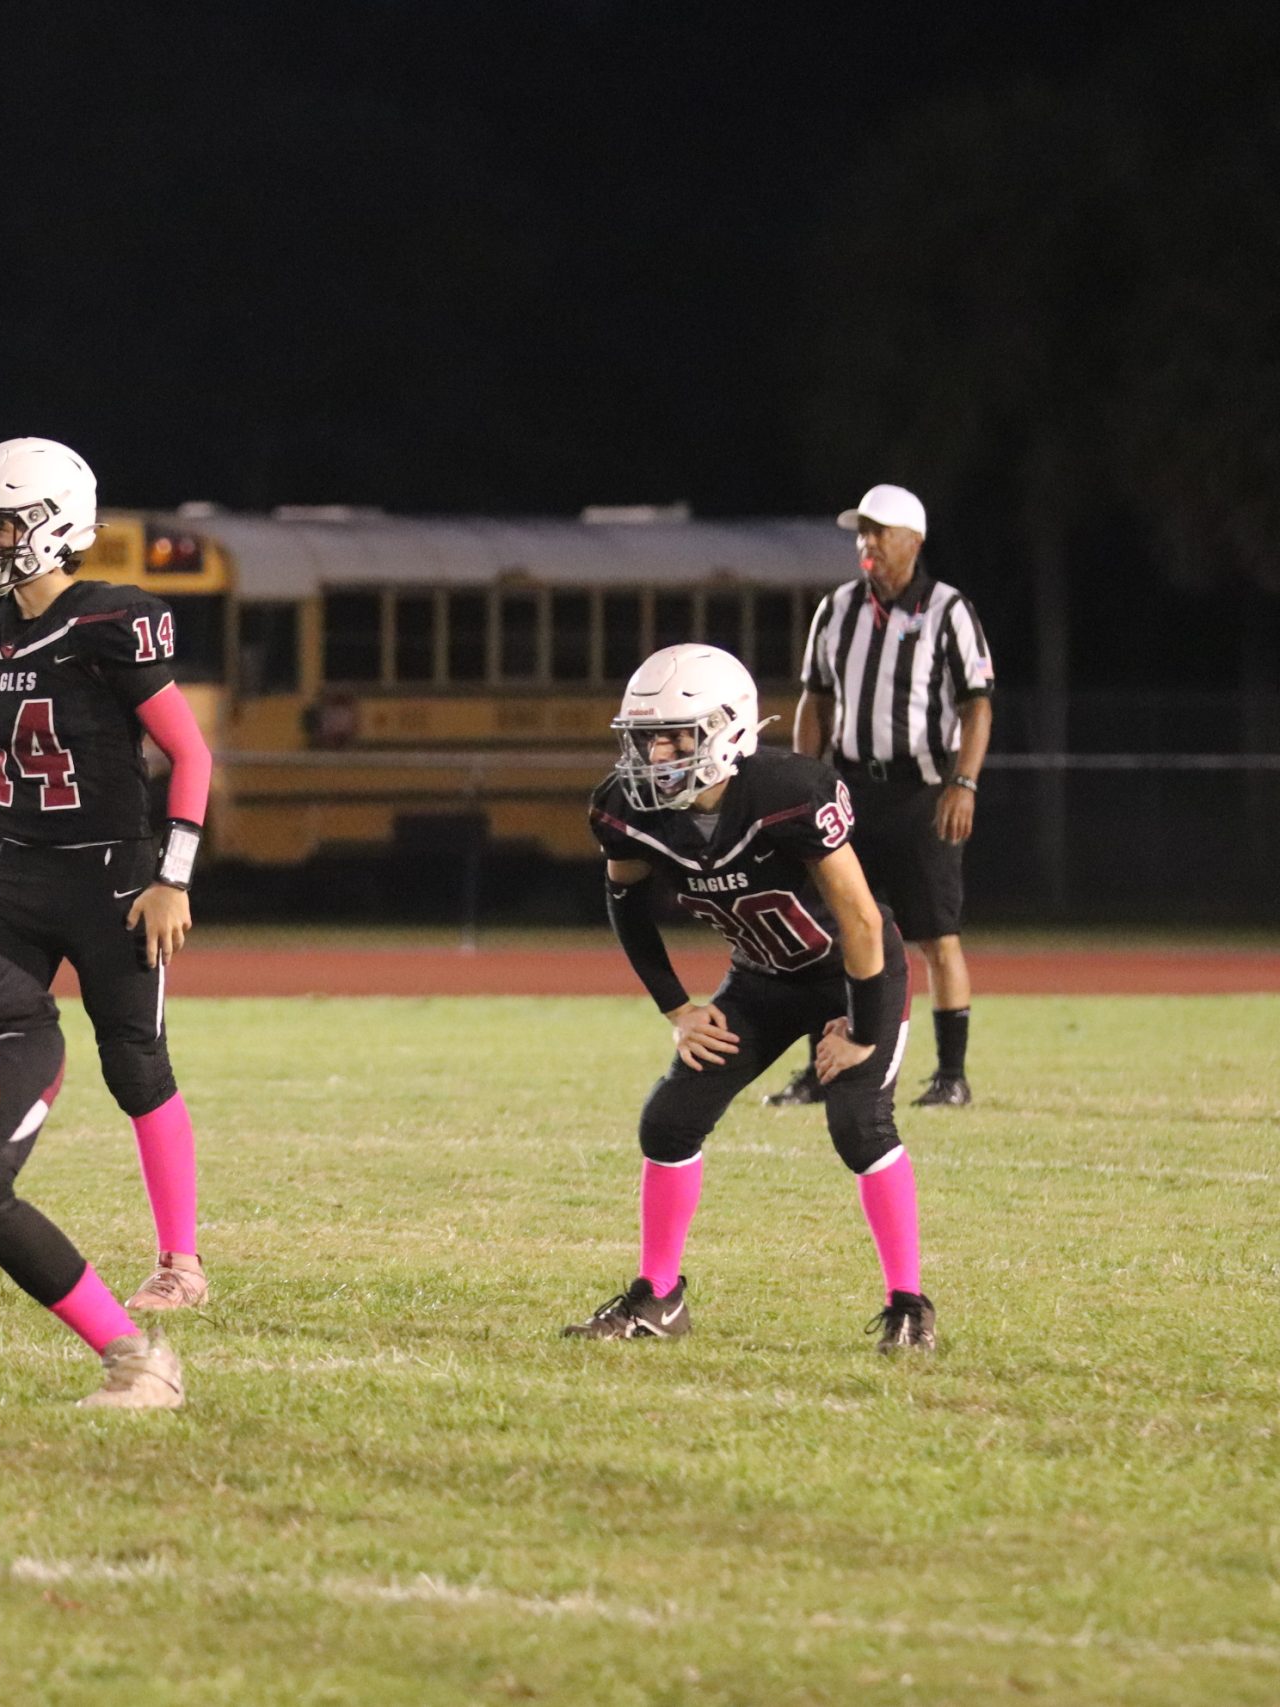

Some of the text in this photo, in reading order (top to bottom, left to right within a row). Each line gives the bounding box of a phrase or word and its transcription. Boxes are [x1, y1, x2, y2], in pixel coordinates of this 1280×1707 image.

[132, 611, 174, 662] 14
[815, 779, 855, 848] 30
[687, 871, 749, 892] EAGLES
[677, 889, 833, 972] 30
